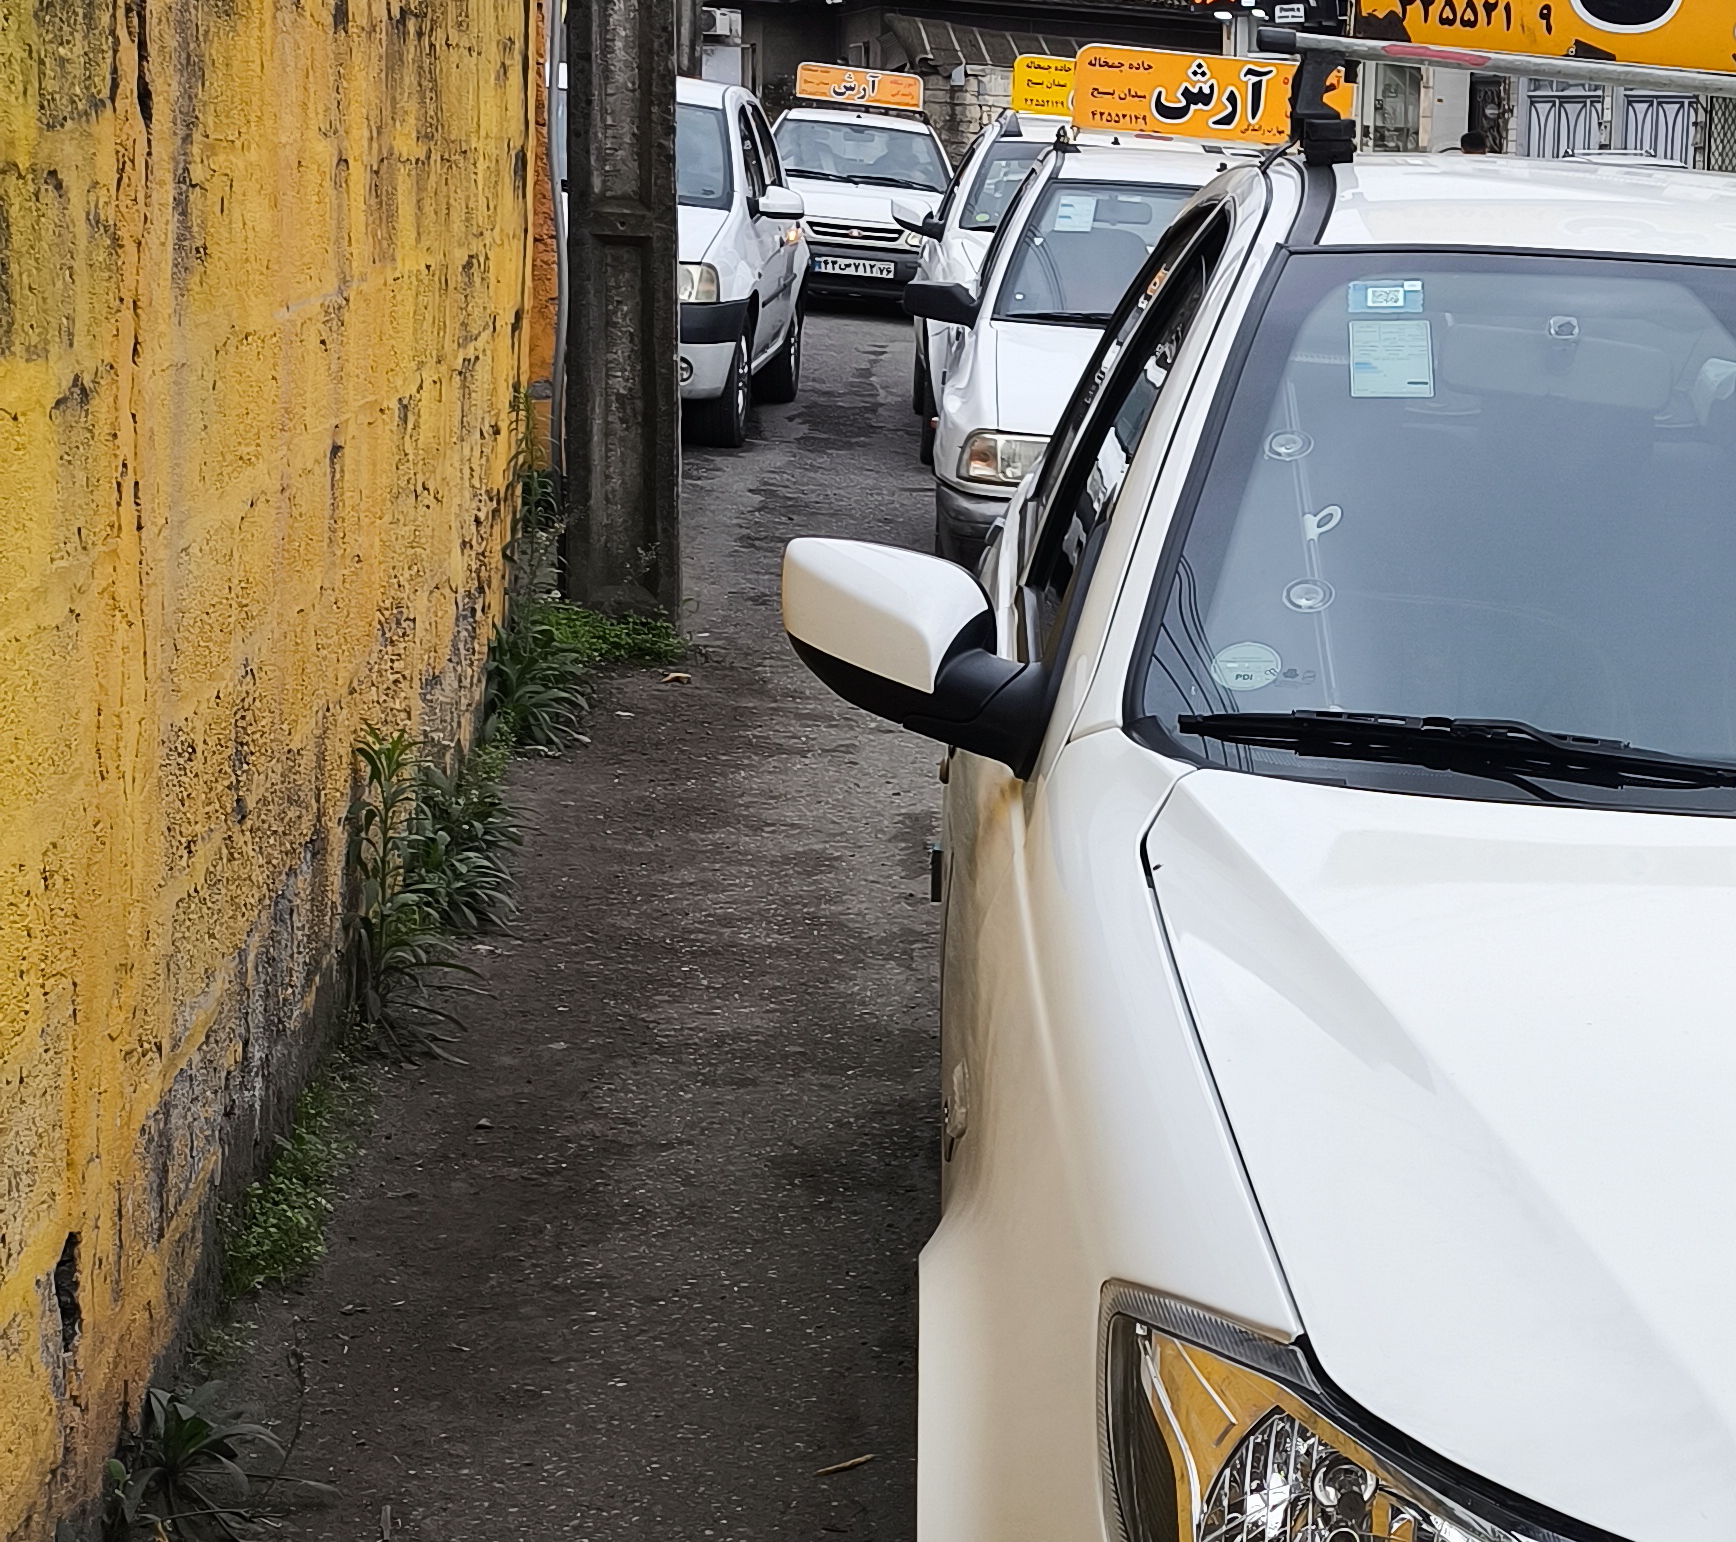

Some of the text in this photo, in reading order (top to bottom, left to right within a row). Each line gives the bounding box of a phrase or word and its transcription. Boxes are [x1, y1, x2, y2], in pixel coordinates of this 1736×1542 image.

[832, 73, 881, 100] آرش
[1152, 60, 1275, 128] آرش
[1235, 673, 1254, 681] PDI
